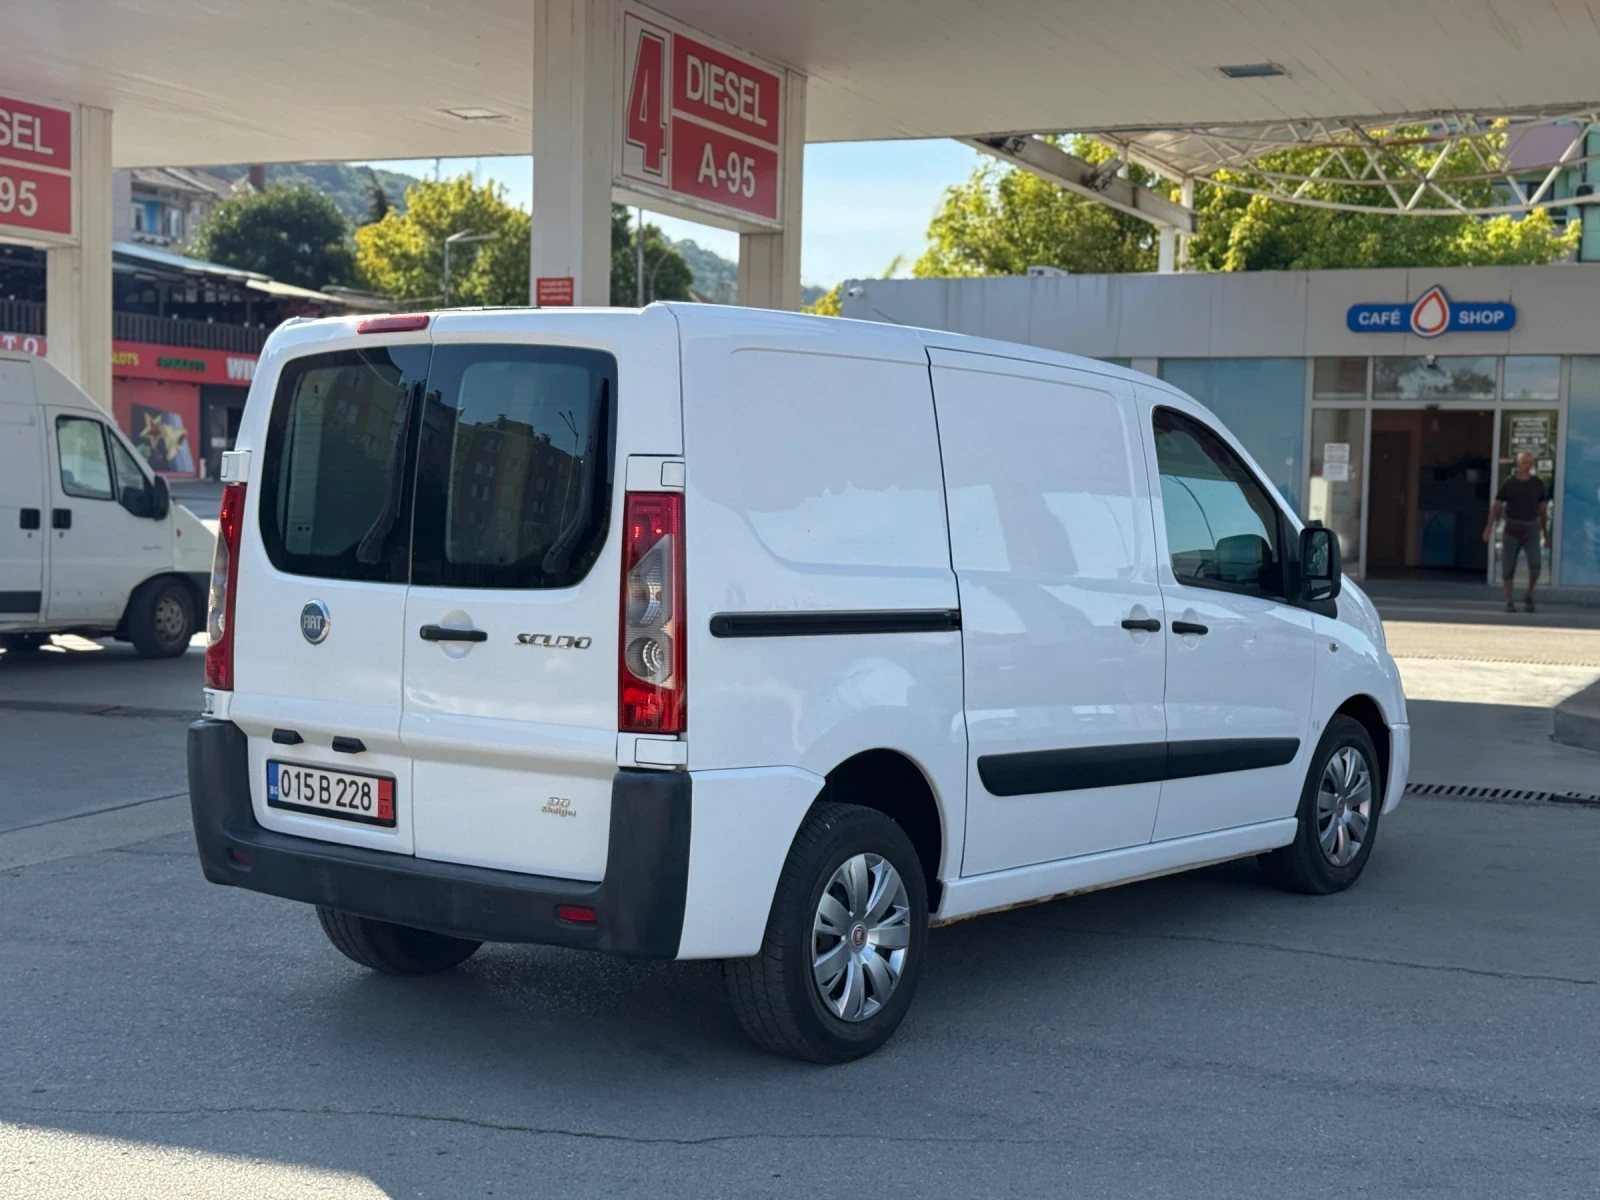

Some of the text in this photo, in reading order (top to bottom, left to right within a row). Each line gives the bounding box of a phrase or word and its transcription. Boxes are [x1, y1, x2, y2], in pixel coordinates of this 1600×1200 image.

[625, 29, 667, 177] 4
[686, 54, 768, 127] DIESEL
[697, 142, 756, 198] A-95
[1358, 308, 1505, 325] CAFÉ SHOP
[303, 614, 323, 630] FIAT
[514, 633, 593, 650] SCUDO
[280, 768, 372, 812] 015B228
